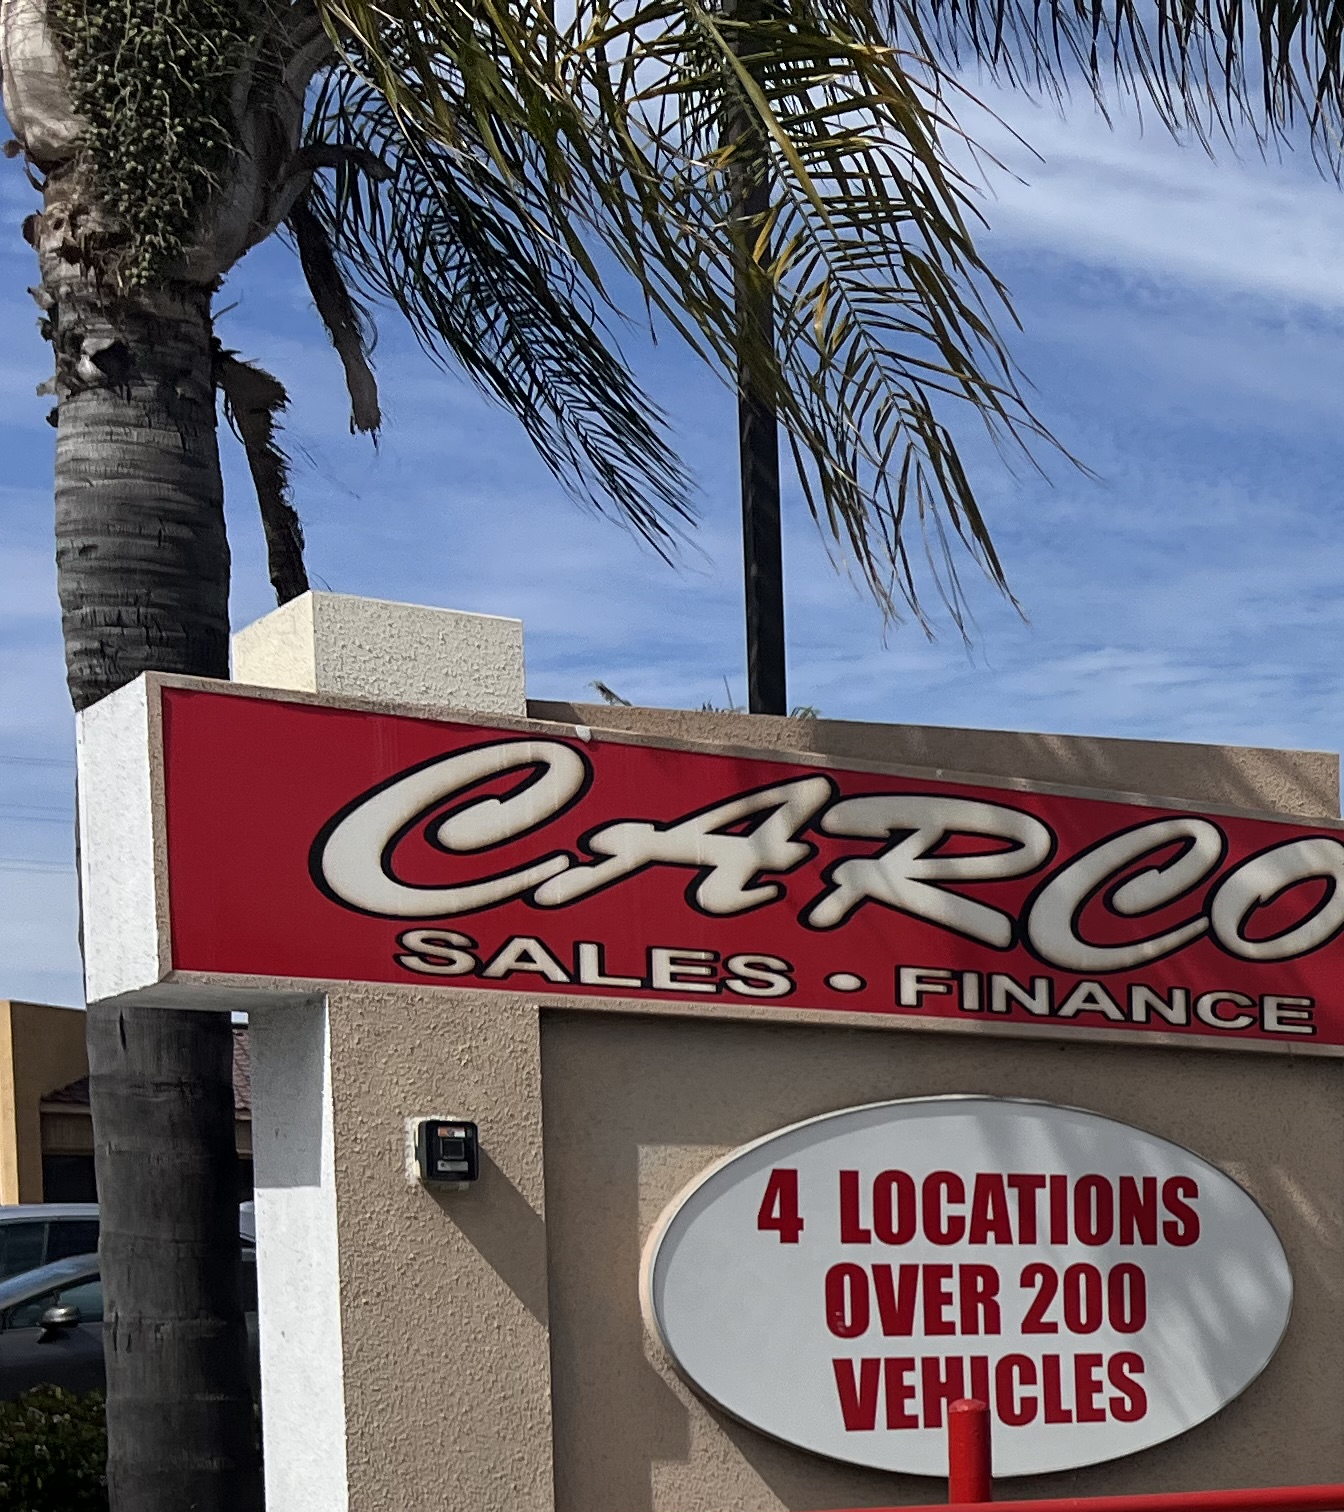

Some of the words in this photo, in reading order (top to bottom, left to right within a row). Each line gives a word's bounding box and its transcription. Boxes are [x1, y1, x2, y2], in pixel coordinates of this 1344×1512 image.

[395, 928, 796, 998] SALES
[896, 966, 1318, 1035] FINANCE
[757, 1168, 804, 1244] 4
[839, 1169, 1201, 1247] LOCATIONS
[824, 1262, 1000, 1339] OVER
[1020, 1262, 1148, 1335] 200
[832, 1350, 1149, 1432] VEHICLES
